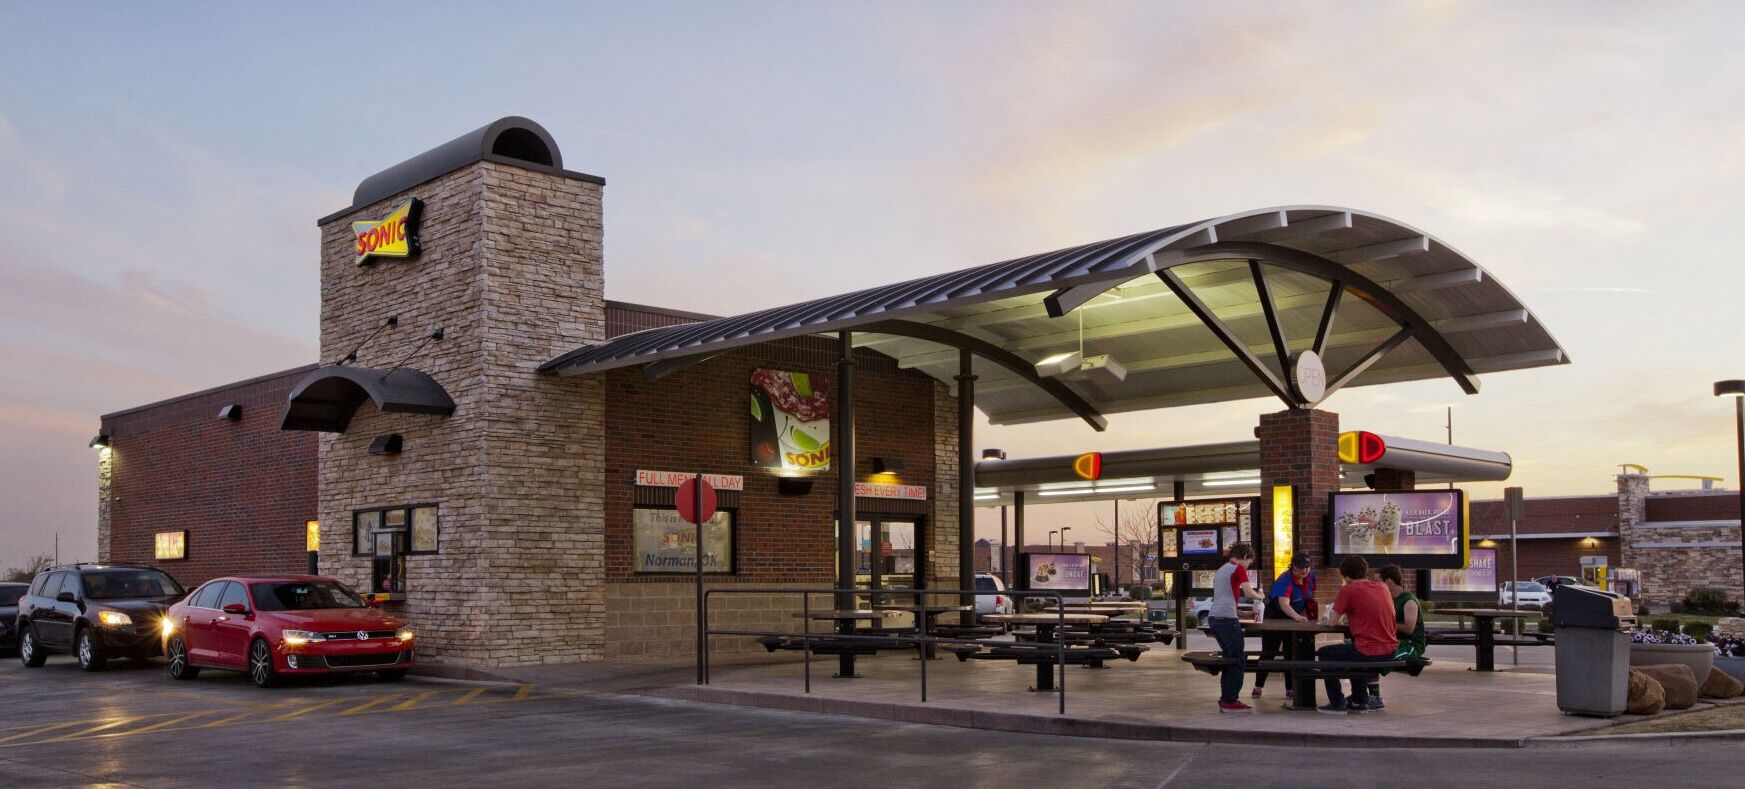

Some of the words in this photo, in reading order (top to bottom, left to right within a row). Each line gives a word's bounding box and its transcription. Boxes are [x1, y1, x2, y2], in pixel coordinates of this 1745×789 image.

[357, 216, 408, 255] SONIC
[1300, 366, 1324, 387] OPEN
[785, 446, 830, 467] SONI
[639, 472, 665, 485] FULL
[668, 474, 695, 487] MEN
[721, 476, 741, 489] DAY
[855, 484, 872, 496] ESH
[875, 485, 901, 497] EVERY
[650, 512, 669, 522] This
[1406, 520, 1451, 536] BLAST
[661, 531, 696, 545] SONI
[1469, 558, 1492, 569] SHAKE
